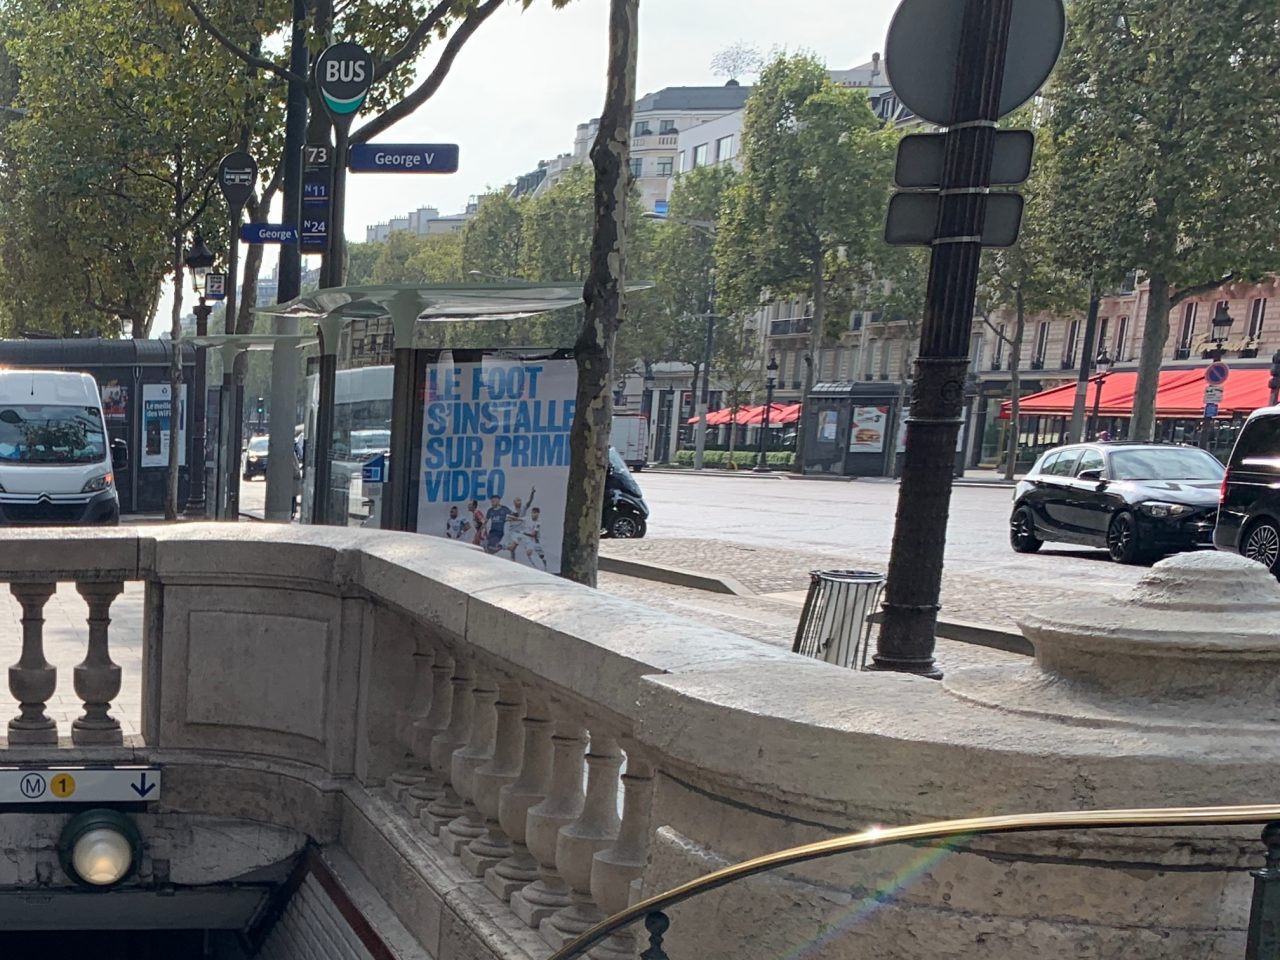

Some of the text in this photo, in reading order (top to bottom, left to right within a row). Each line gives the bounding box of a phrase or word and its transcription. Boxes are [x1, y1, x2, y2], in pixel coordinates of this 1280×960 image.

[326, 60, 365, 82] BUS
[308, 148, 328, 163] 73
[375, 152, 435, 168] George V
[258, 229, 292, 240] George
[428, 366, 544, 401] LE FOOT
[427, 399, 577, 436] S'INSTALLE
[425, 436, 484, 470] SUR
[424, 468, 506, 503] VIDEO
